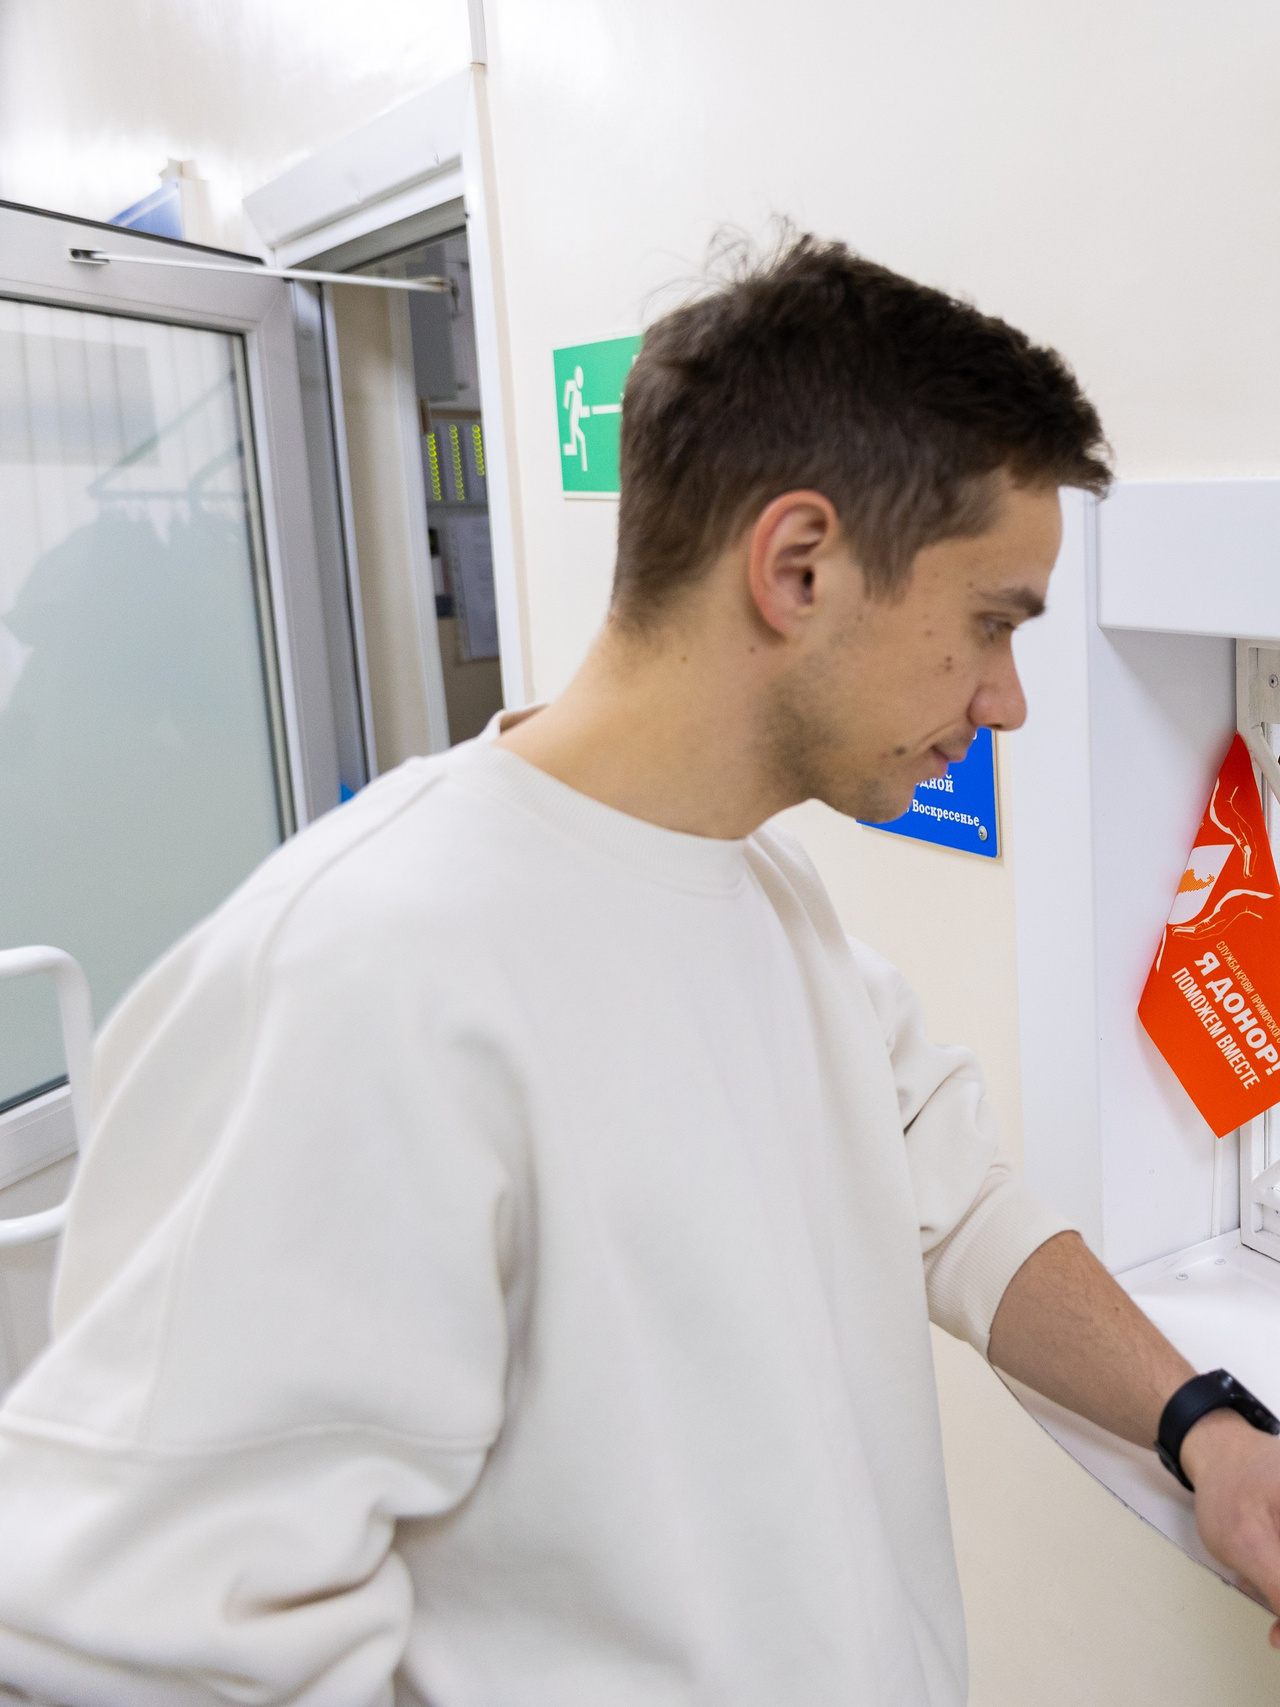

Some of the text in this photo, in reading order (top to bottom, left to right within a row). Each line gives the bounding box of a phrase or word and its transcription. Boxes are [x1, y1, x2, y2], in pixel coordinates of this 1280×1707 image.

[917, 774, 954, 793] дной
[912, 799, 980, 827] Воскресенье
[1194, 951, 1221, 977] Я
[1216, 940, 1240, 973] СЛУЖБА
[1235, 969, 1255, 995] КРОВИ
[1171, 967, 1260, 1090] ПОМОЖЕМ ВМЕСТЕ
